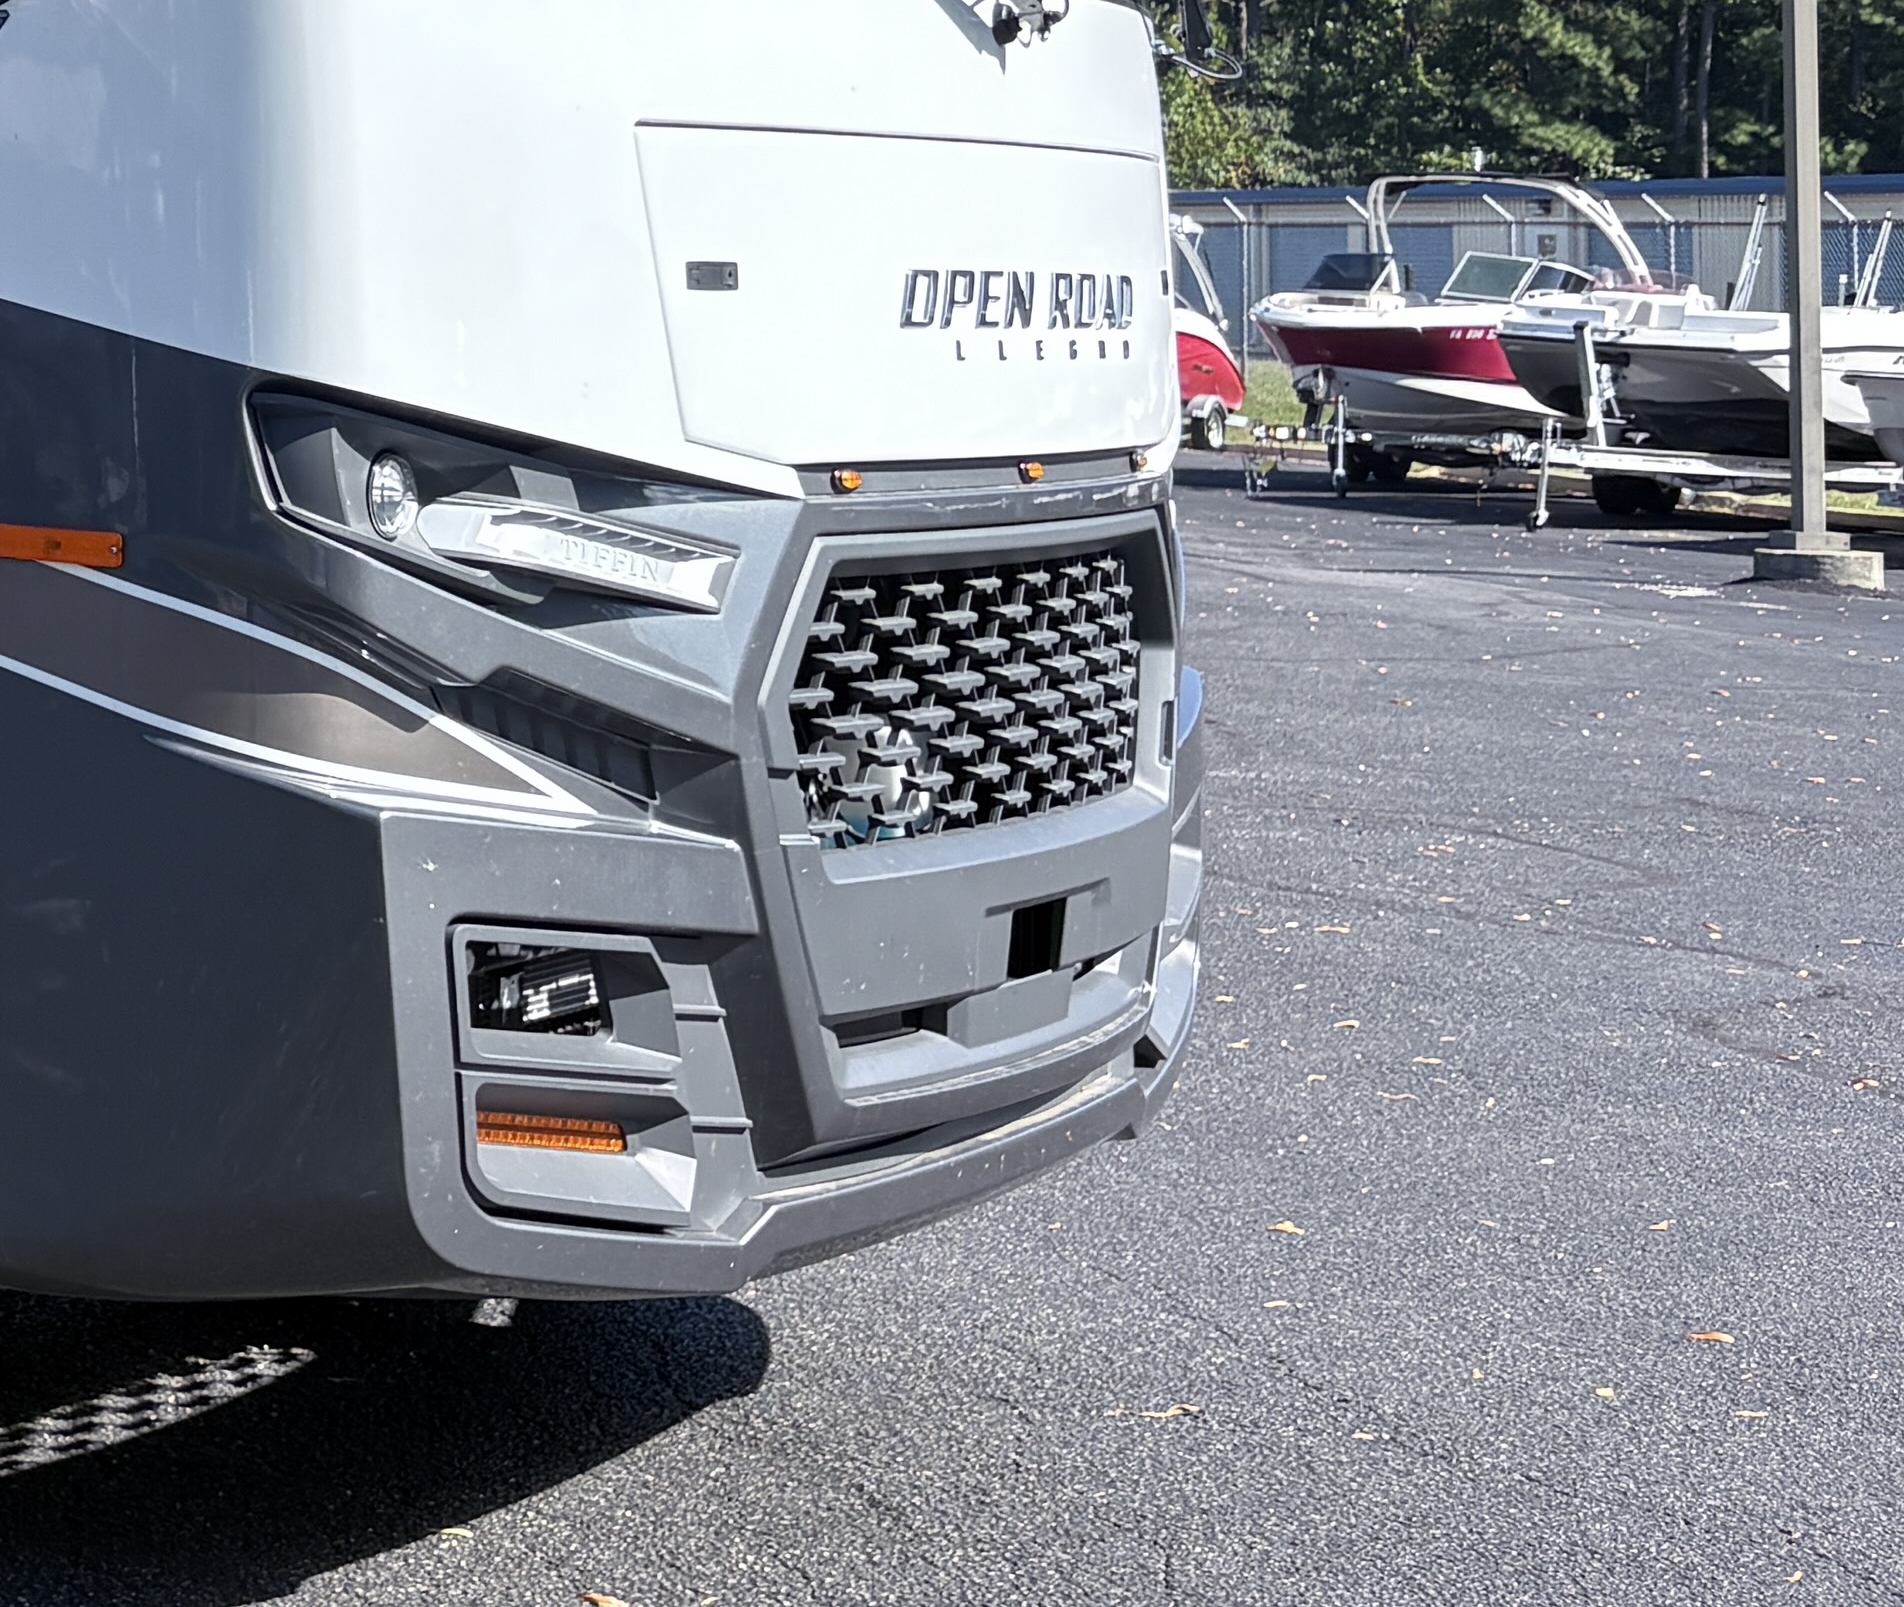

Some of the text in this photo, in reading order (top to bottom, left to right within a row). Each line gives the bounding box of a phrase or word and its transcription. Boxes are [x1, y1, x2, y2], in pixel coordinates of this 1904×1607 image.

[899, 268, 1134, 331] OPEN ROAD
[560, 538, 659, 582] TIFFIN
